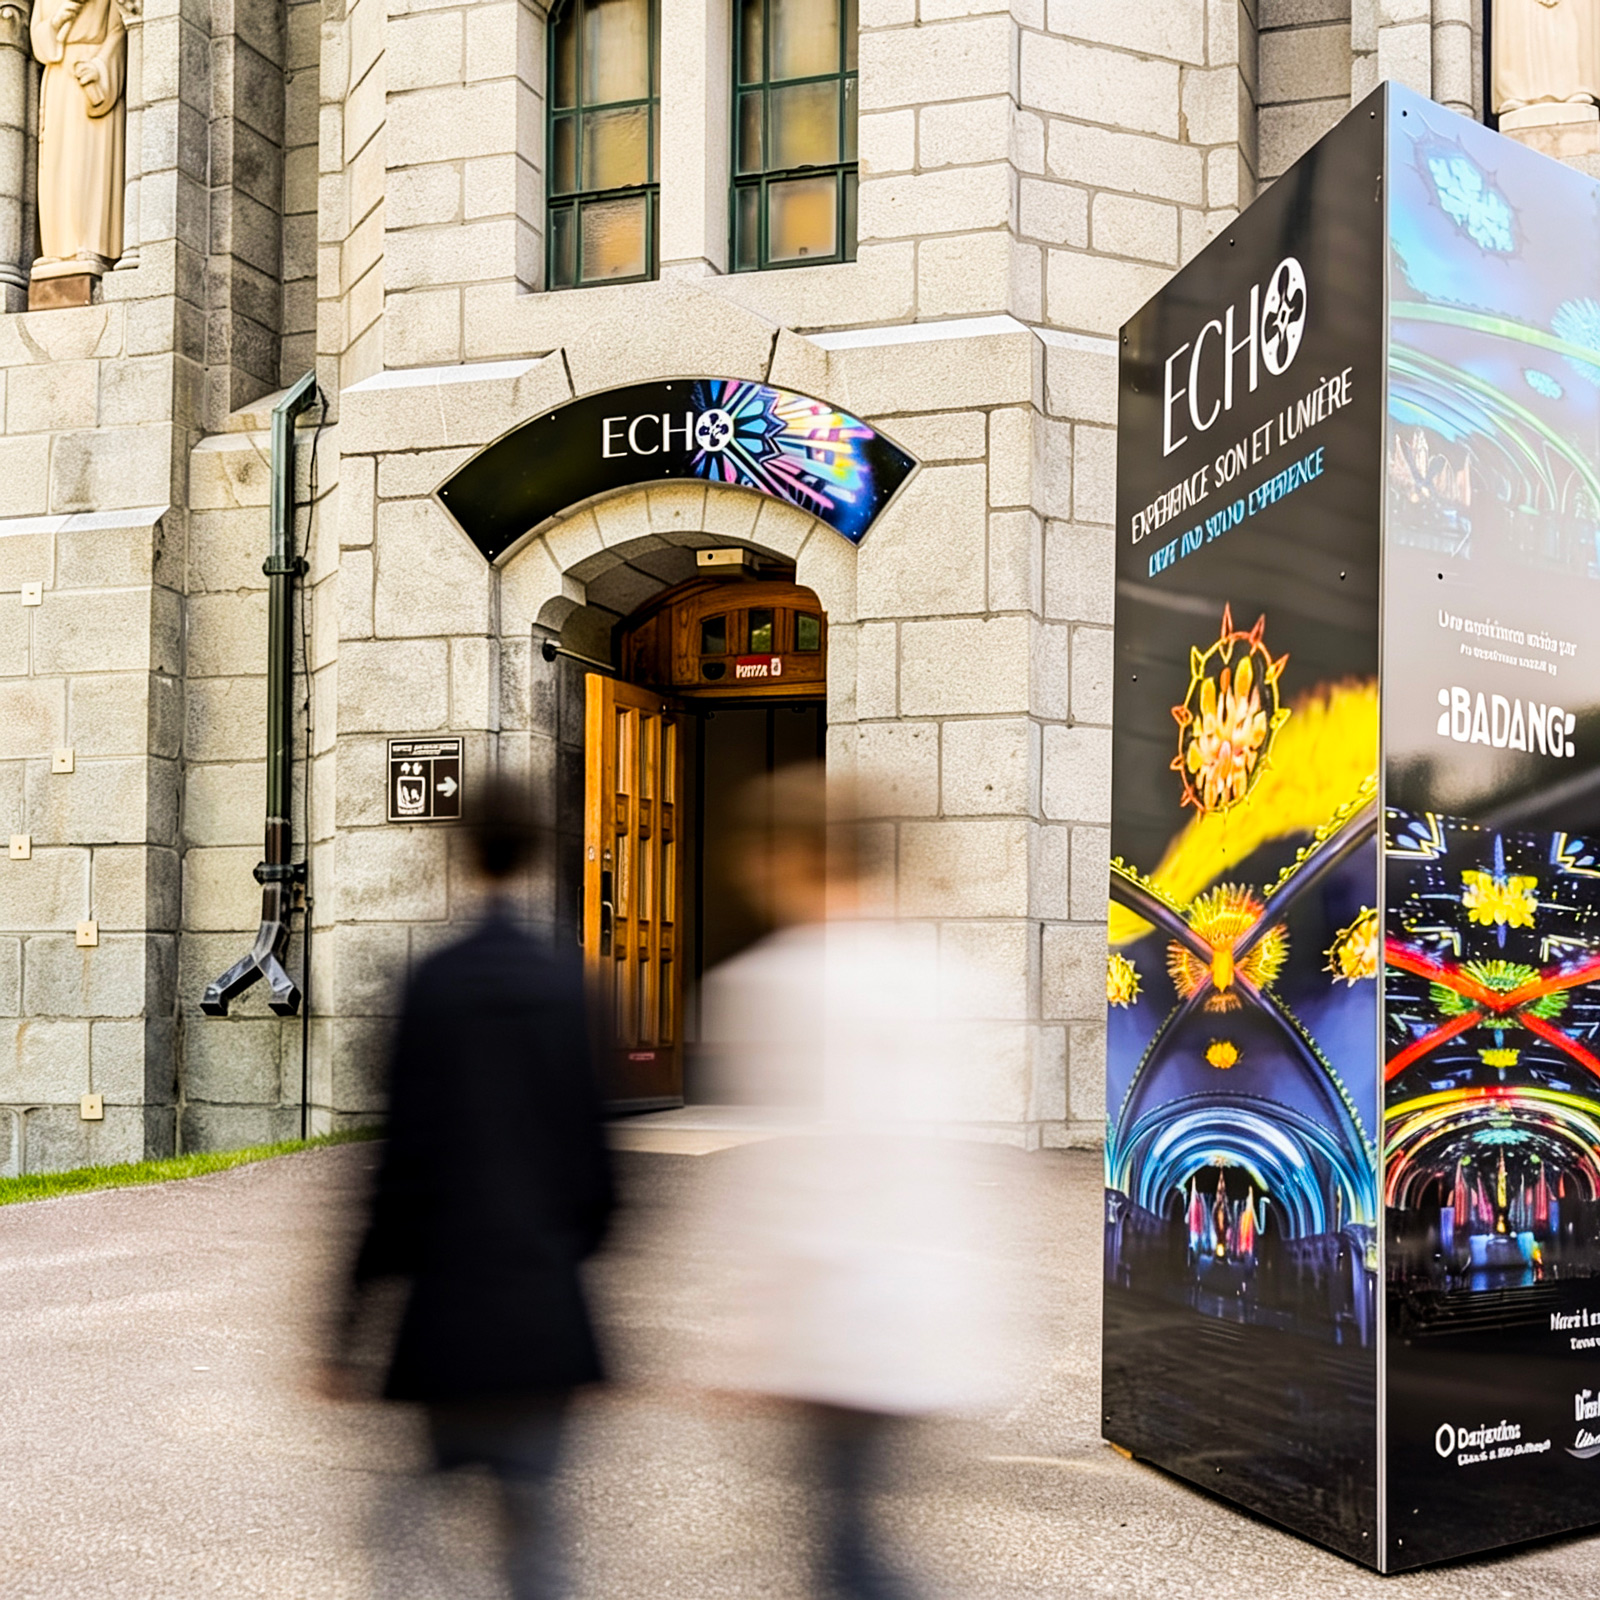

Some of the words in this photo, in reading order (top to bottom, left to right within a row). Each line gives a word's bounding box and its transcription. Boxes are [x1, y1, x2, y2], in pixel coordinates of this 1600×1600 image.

[1163, 257, 1307, 457] ECHO
[602, 408, 735, 459] ECHO
[1214, 437, 1248, 489] SON
[1252, 419, 1274, 465] ET
